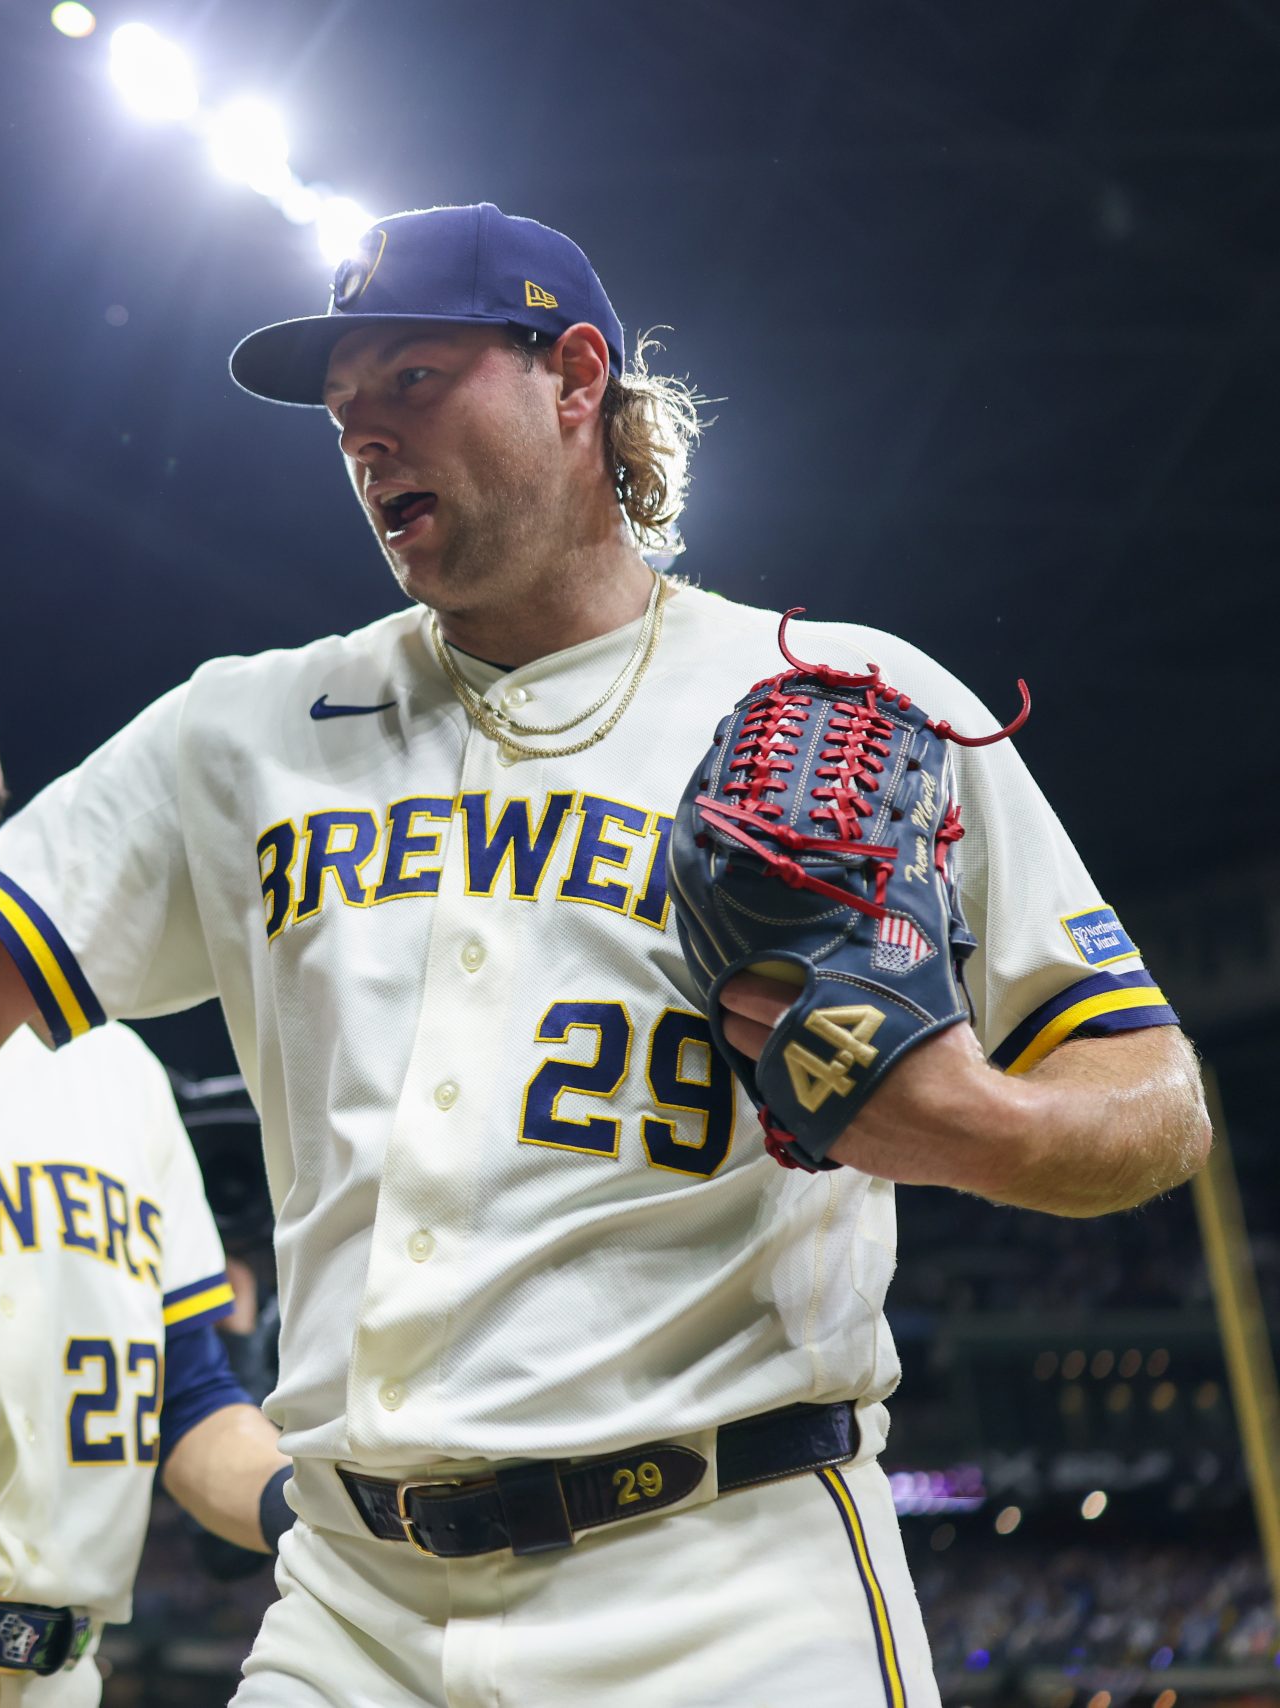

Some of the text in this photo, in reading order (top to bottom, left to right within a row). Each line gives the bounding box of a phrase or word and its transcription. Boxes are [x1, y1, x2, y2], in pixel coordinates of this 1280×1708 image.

[518, 1000, 737, 1179] 29
[783, 1004, 887, 1114] 44
[64, 1336, 165, 1467] 22
[612, 1461, 663, 1505] 29
